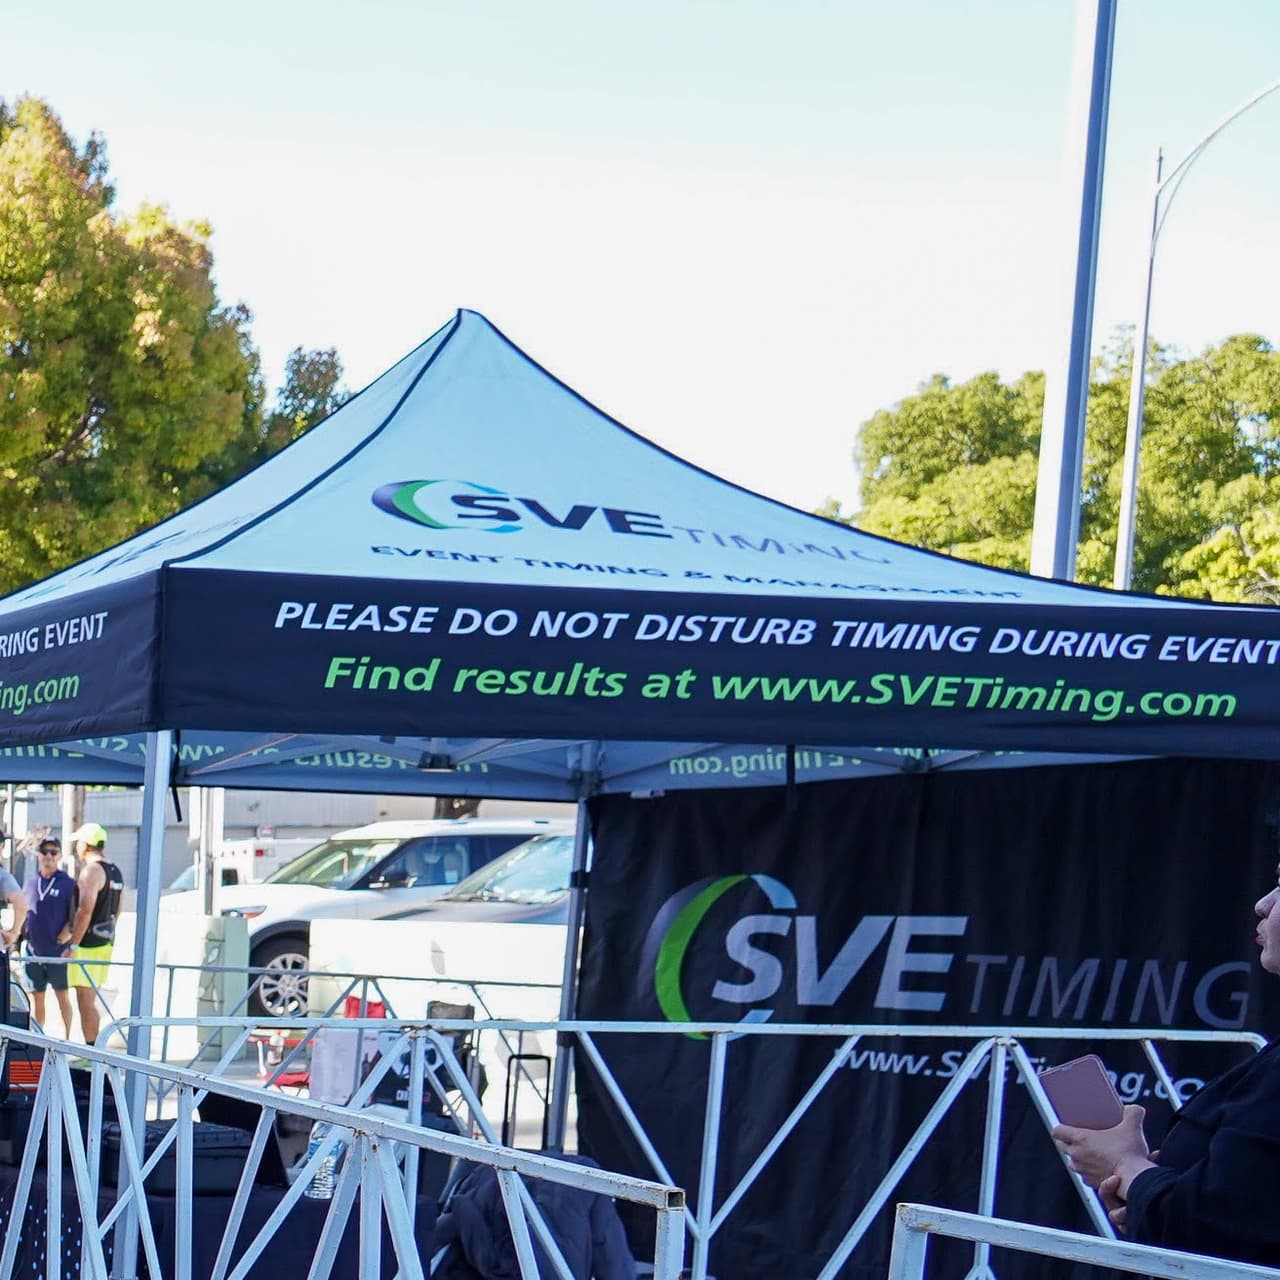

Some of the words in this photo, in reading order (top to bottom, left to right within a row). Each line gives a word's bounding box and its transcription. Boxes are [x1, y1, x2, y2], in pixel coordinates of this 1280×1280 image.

[448, 493, 674, 539] SVE
[370, 545, 505, 566] EVENT
[521, 556, 669, 579] TIMING
[44, 611, 109, 650] EVENT
[274, 601, 440, 634] PLEASE
[448, 608, 520, 636] DO
[529, 610, 630, 640] NOT
[634, 613, 817, 645] DISTURB
[829, 619, 981, 653] TIMING
[989, 627, 1151, 660] DURING
[1158, 635, 1280, 665] EVENT
[324, 656, 442, 692] Find
[452, 662, 628, 698] results
[640, 668, 697, 699] at
[710, 673, 1238, 722] www.SVETiming.com
[712, 914, 969, 1011] SVE
[964, 955, 1253, 1030] TIMING
